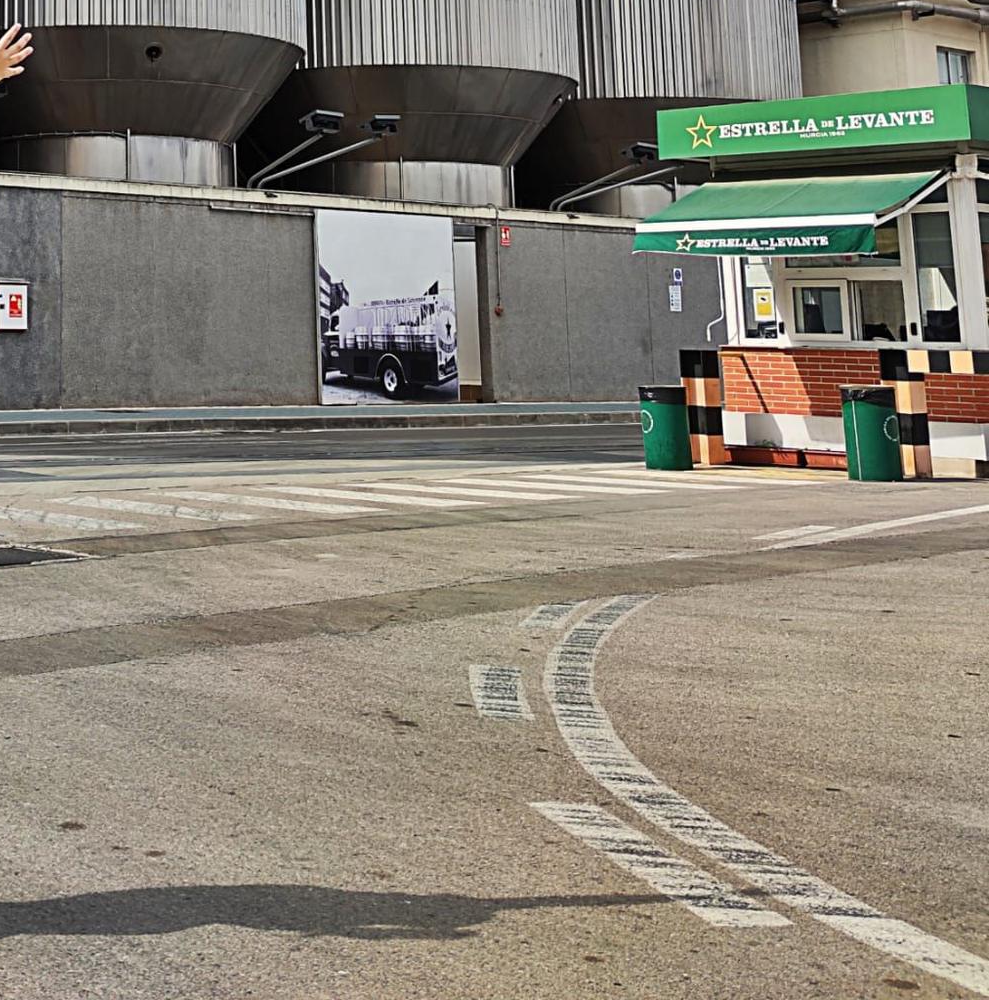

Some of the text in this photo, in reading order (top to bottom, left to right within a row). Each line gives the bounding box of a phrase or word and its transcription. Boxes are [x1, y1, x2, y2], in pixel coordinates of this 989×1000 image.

[719, 109, 935, 138] ESTRELLA DE LEVANTE
[696, 237, 760, 248] ESTRELLA
[769, 236, 829, 247] LEVANTE
